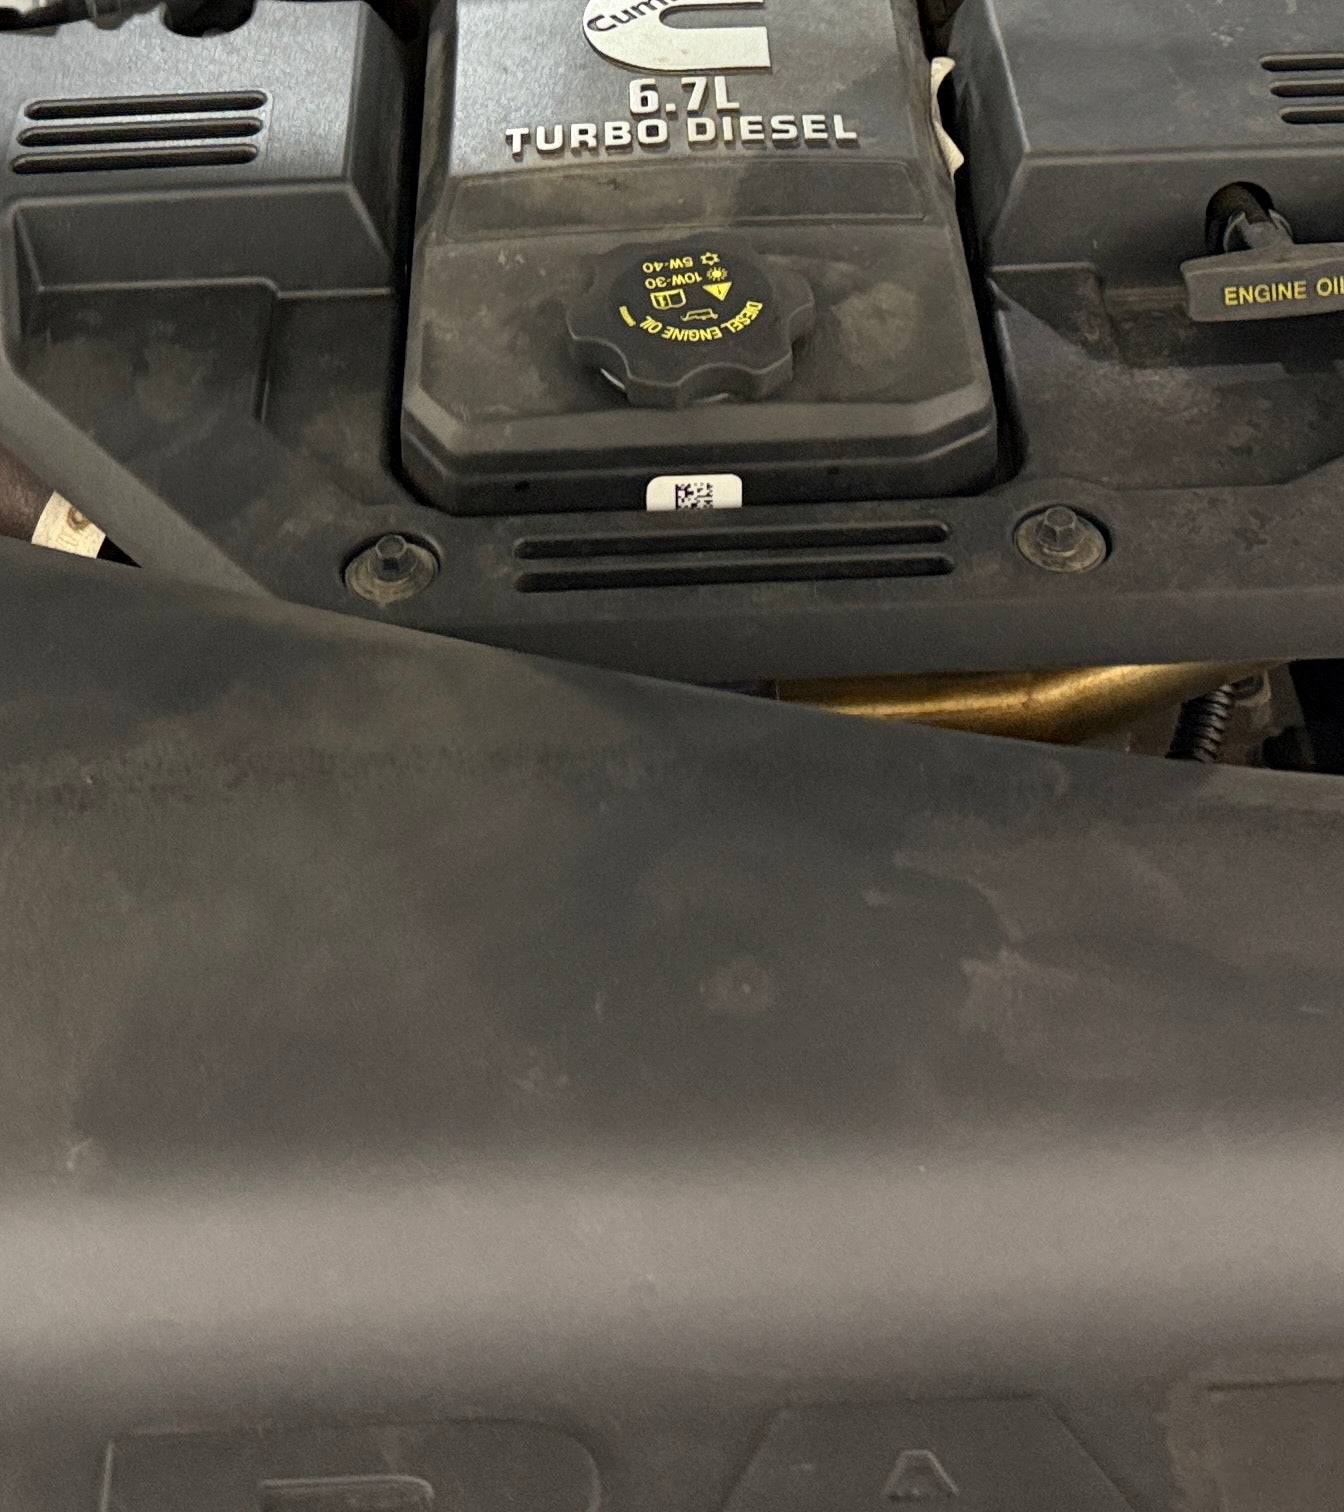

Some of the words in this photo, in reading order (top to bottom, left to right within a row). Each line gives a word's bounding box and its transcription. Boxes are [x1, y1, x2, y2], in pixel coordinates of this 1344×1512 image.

[627, 75, 740, 115] 6.7L
[505, 119, 669, 156] TURBO
[686, 113, 859, 144] DIESEL
[642, 255, 694, 273] 5W-40
[644, 271, 703, 290] 10W-30
[1223, 279, 1307, 306] ENGINE
[639, 316, 663, 335] OIL
[721, 301, 763, 333] DIESEL
[661, 325, 723, 342] ENGINE
